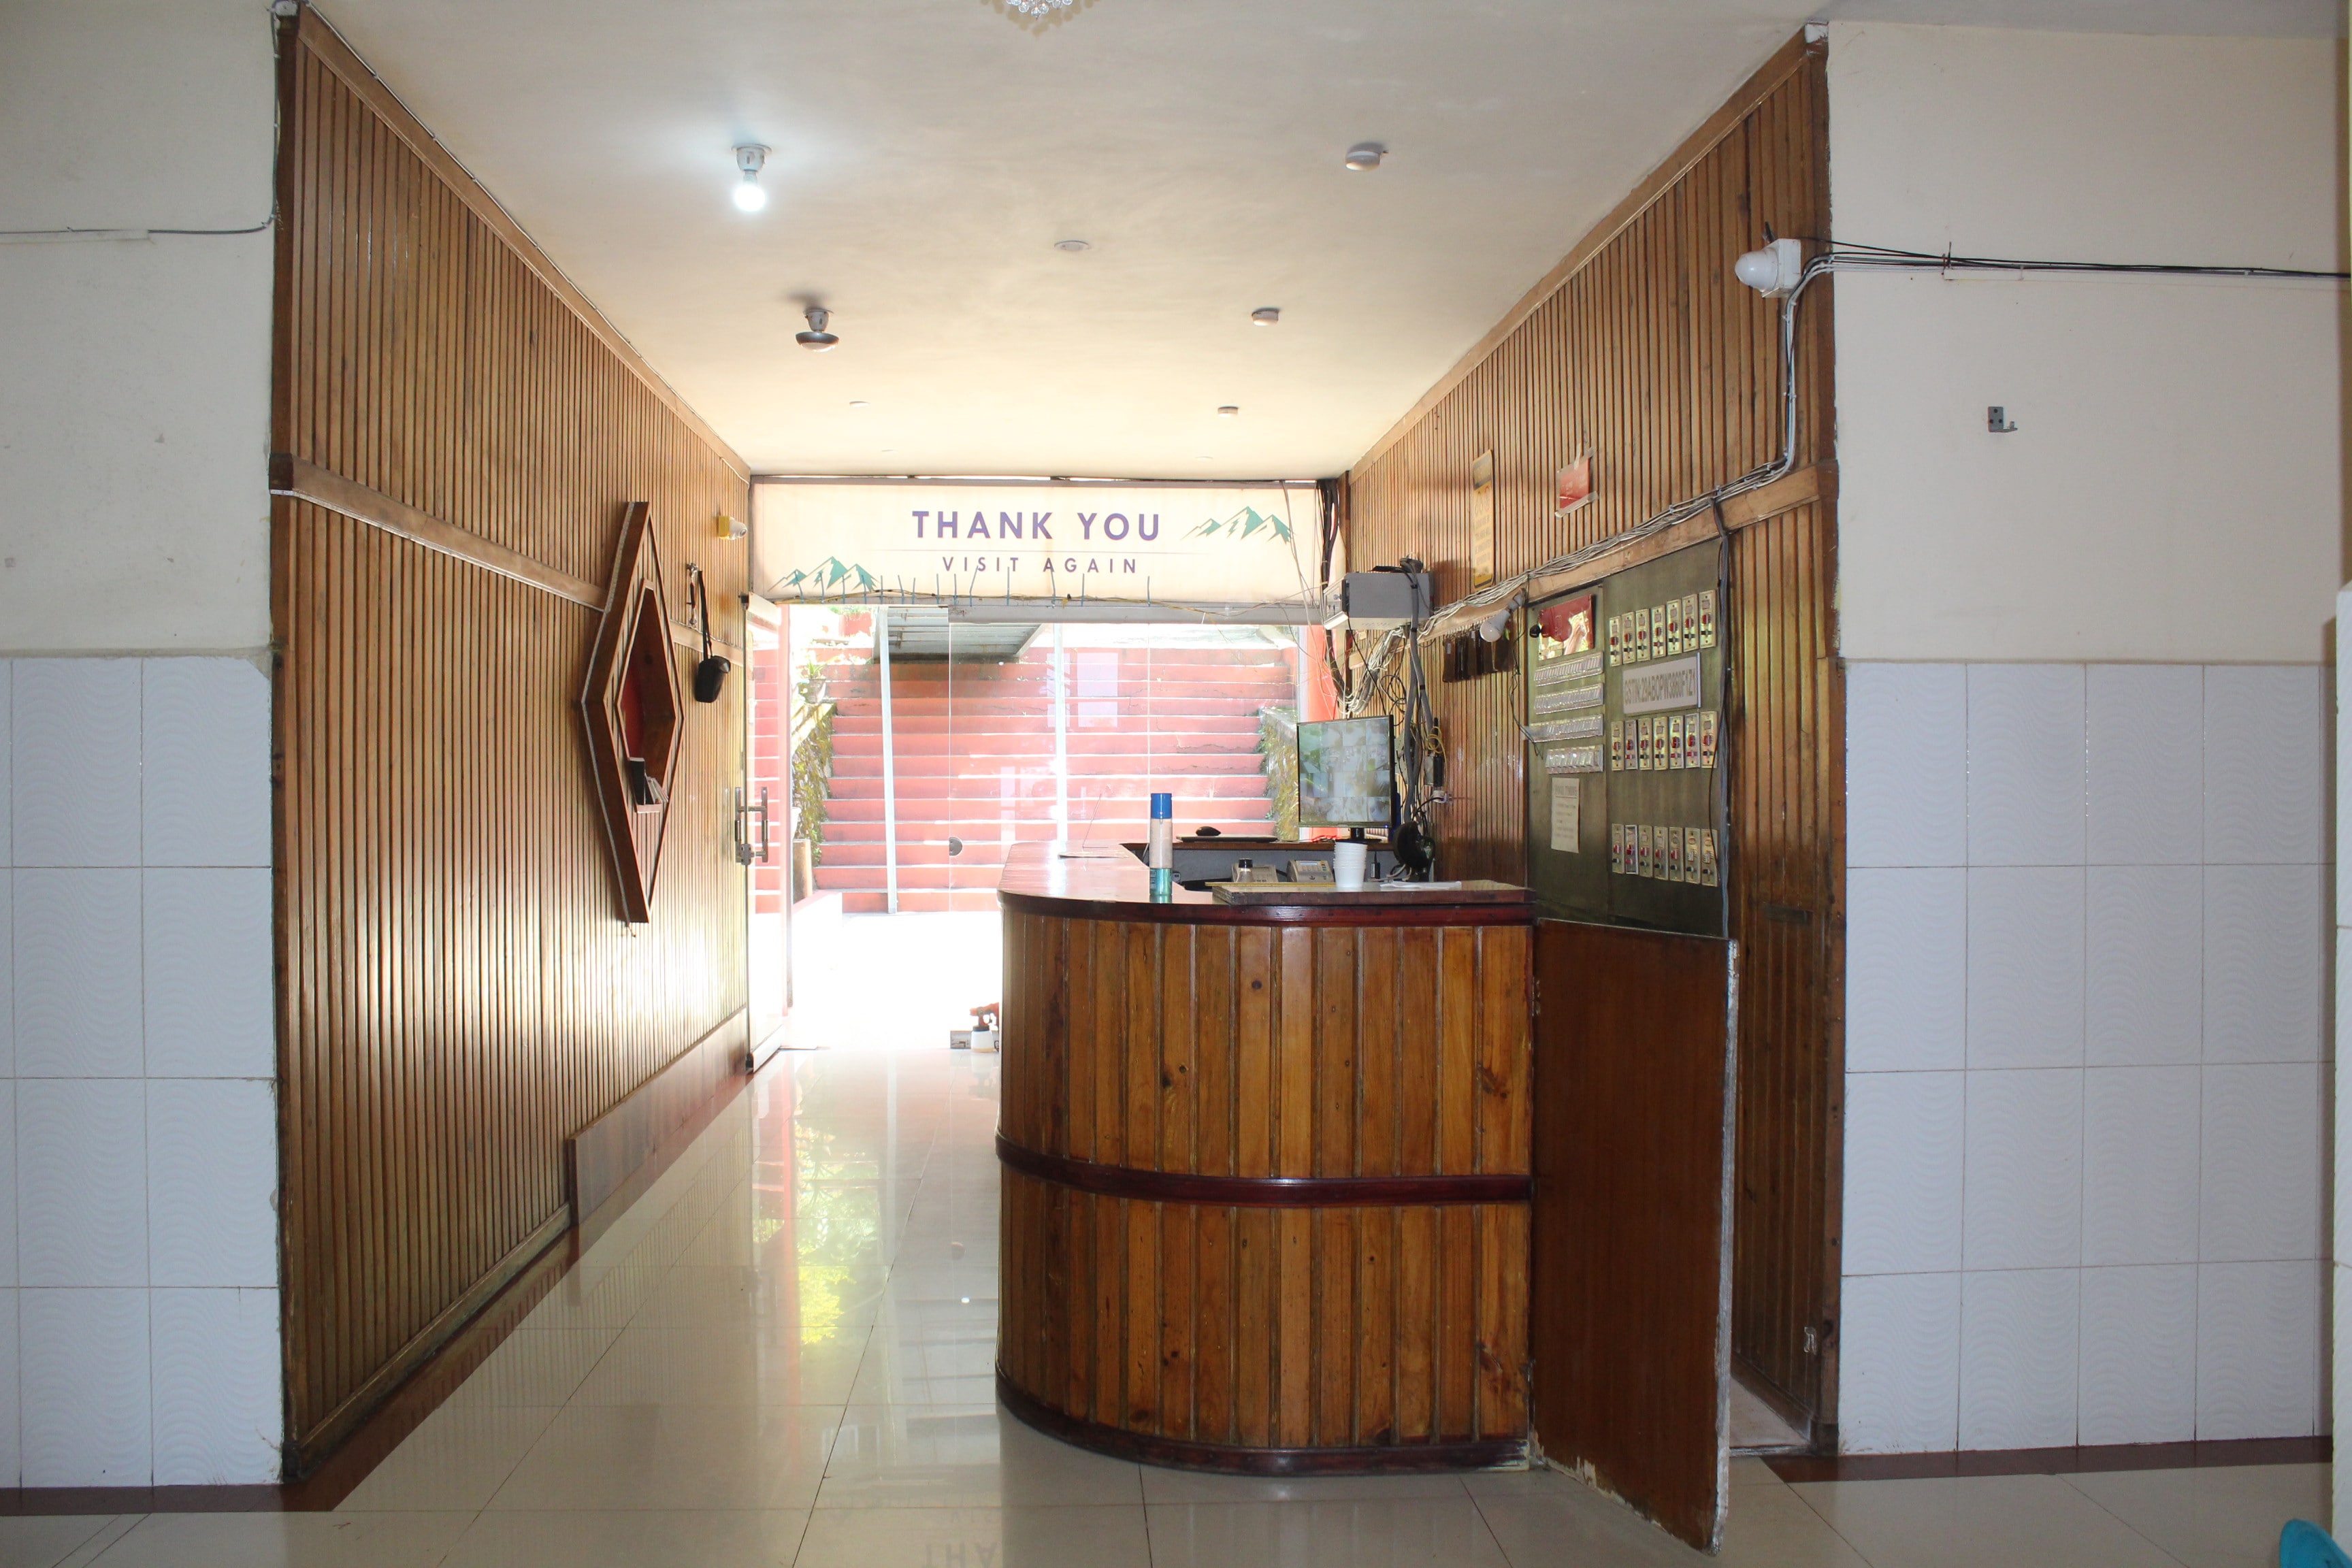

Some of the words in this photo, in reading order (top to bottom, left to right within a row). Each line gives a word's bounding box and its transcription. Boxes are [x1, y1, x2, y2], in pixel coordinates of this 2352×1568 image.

[912, 510, 1054, 540] THANK
[1077, 512, 1160, 542] YOU
[943, 556, 1019, 572] VISIT
[1043, 557, 1136, 574] AGAIN
